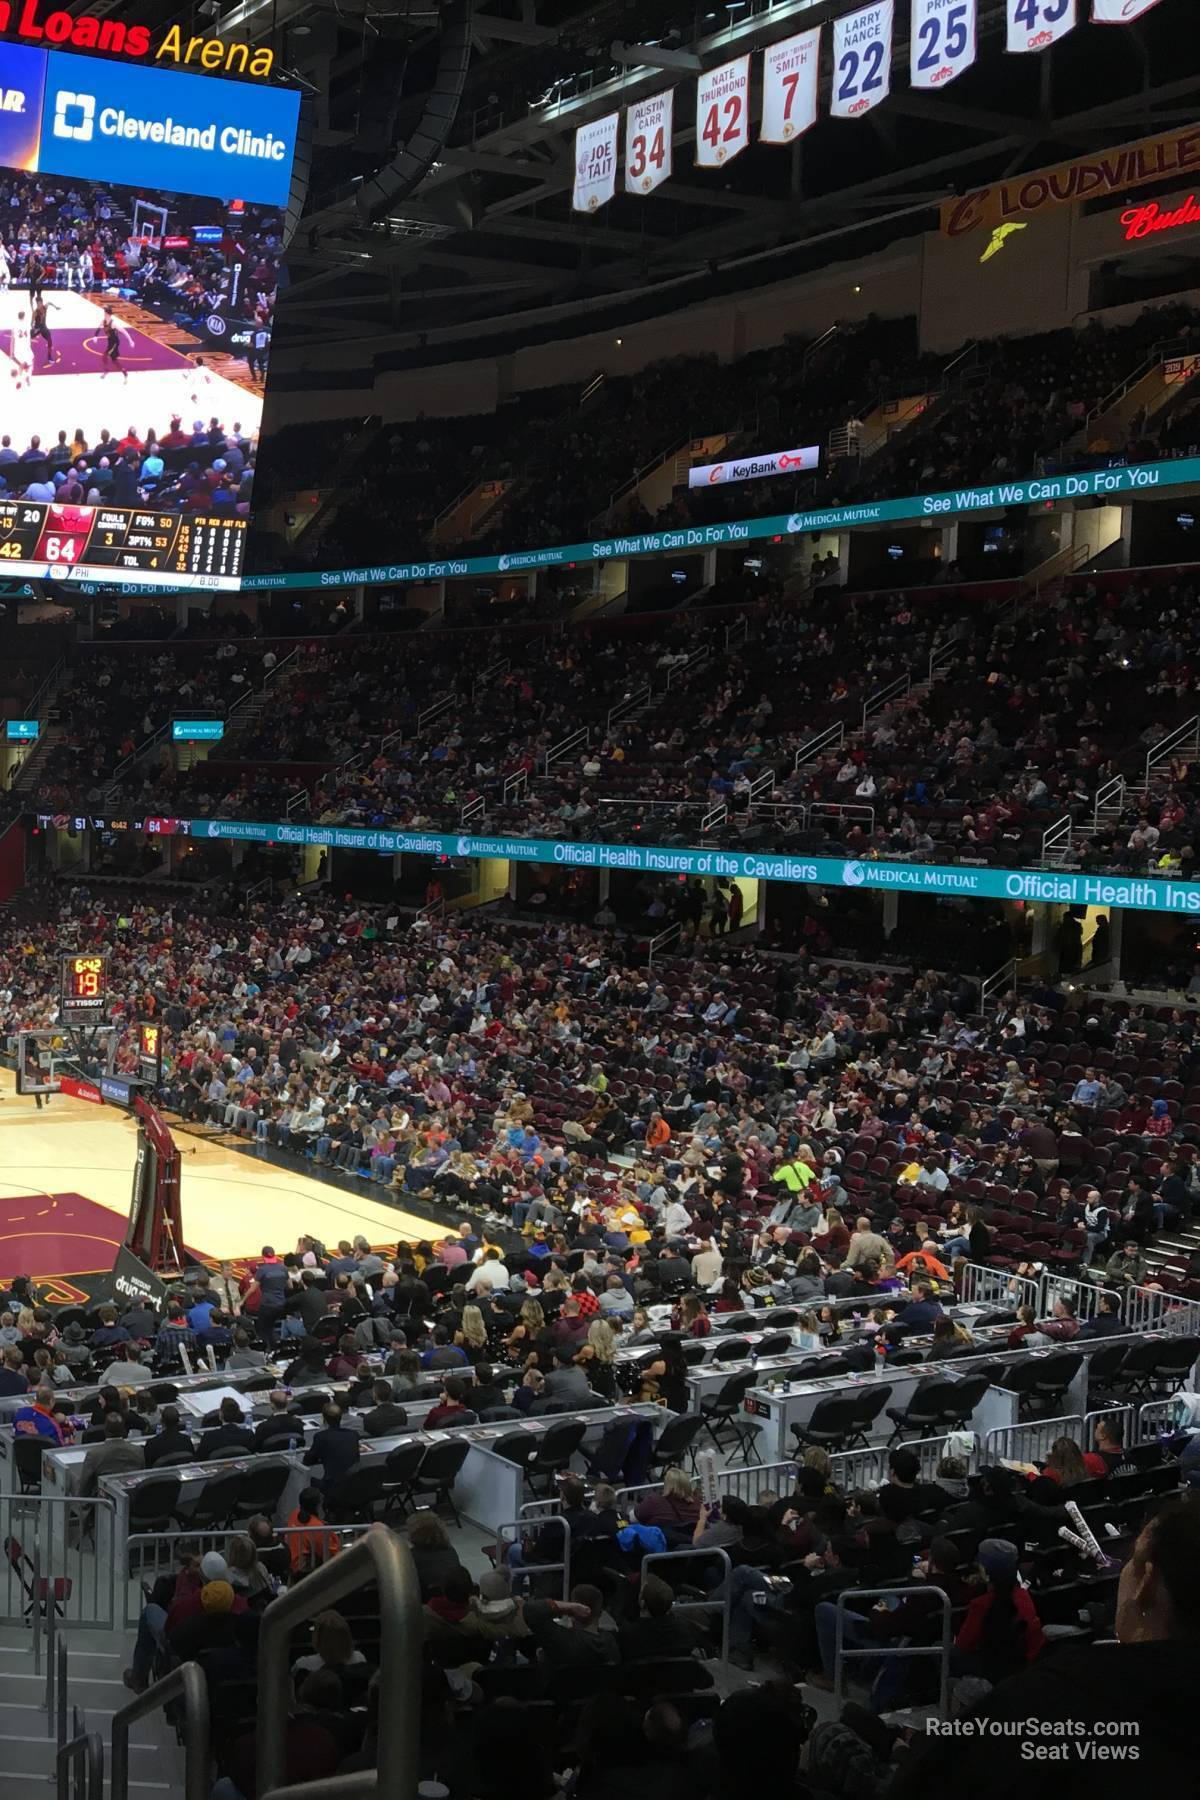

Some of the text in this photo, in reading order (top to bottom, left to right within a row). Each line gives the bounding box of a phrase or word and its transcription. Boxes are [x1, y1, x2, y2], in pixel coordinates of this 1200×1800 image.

[845, 10, 881, 34] LARRY
[18, 0, 150, 57] Loans
[156, 25, 274, 77] Arena
[843, 23, 881, 48] NANCE
[918, 5, 967, 71] 25
[776, 53, 807, 74] SMITH
[838, 41, 885, 100] 22
[712, 68, 735, 86] NATE
[700, 76, 746, 104] THURMOND
[783, 72, 799, 120] 7
[635, 100, 665, 120] AUSTIN
[639, 113, 661, 130] CARR
[702, 96, 742, 147] 42
[100, 109, 285, 160] Cleveland Clinic
[591, 141, 612, 162] JOE
[630, 127, 665, 177] 34
[588, 157, 612, 180] TAIT
[1001, 133, 1200, 215] LOUDVILLE
[733, 460, 776, 478] KeyBank
[923, 468, 1159, 513] See What We Can Do For You
[24, 510, 40, 523] 20
[102, 513, 124, 523] FOULS
[136, 516, 172, 528] FG% 50
[804, 508, 880, 526] MEDICAL MUTUAL
[47, 538, 75, 561] 64
[105, 533, 113, 545] 3
[128, 536, 167, 546] 3PT% 53
[593, 525, 748, 557] See What We Can Do For You
[124, 556, 138, 566] TOL
[511, 552, 563, 565] MEDICAL MUTUAL
[76, 569, 88, 577] PHI
[257, 577, 286, 585] MUTUAL
[321, 562, 467, 584] See What We Can Do For You
[75, 818, 86, 829] 51
[111, 821, 127, 829] 6:42
[149, 821, 160, 832] 64
[221, 825, 266, 836] MEDICAL MUTUAL
[277, 827, 442, 852] Official Health Insurer of the Cavaliers
[472, 842, 538, 855] MEDICAL MUTUAL
[554, 844, 818, 880] Official Health Insurer of the Cavaliers
[867, 868, 978, 888] MEDICAL MUTUAL
[1007, 874, 1156, 905] Official Health
[75, 959, 101, 973] 6:42
[79, 973, 97, 996] 19
[116, 1276, 138, 1297] drug
[131, 1277, 151, 1294] DISCOUNT
